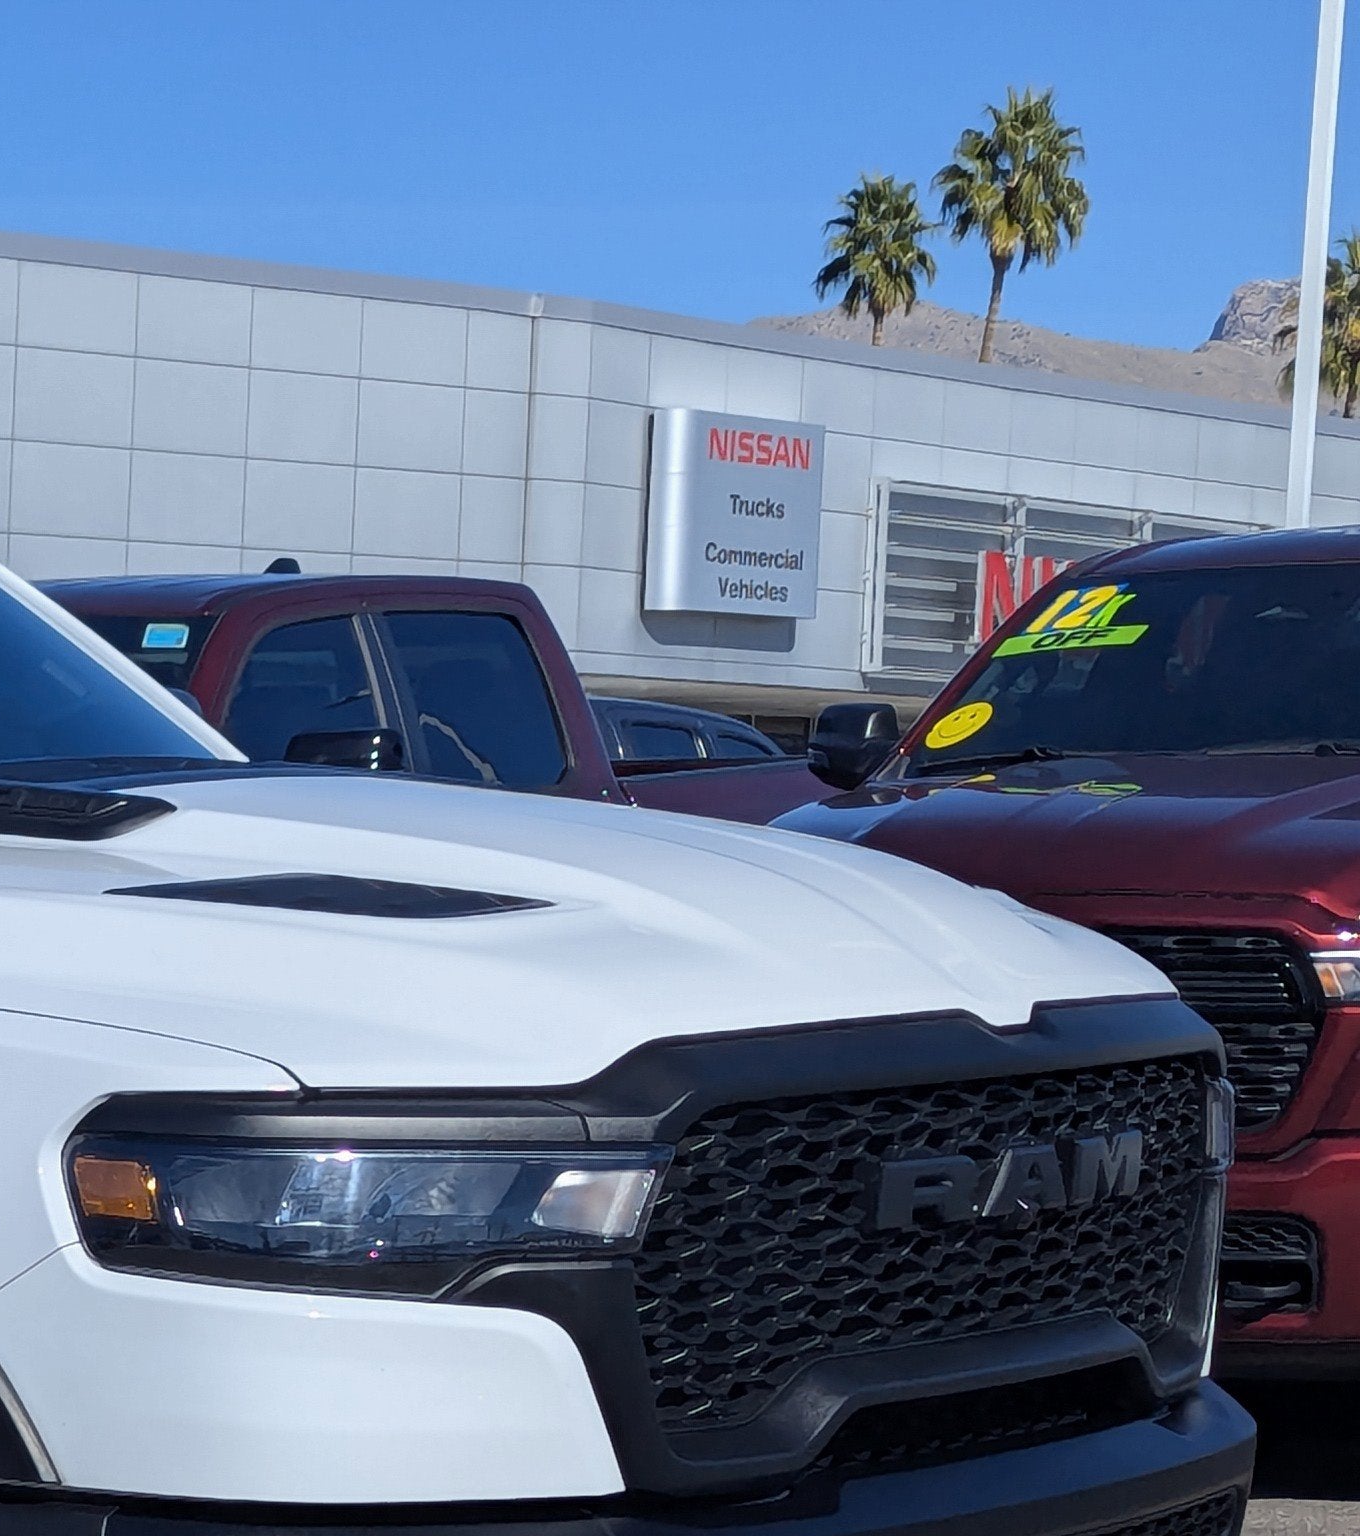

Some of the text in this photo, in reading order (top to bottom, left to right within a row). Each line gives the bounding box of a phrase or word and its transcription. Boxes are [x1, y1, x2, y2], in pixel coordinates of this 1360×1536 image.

[708, 426, 812, 471] NISSAN
[729, 494, 786, 520] Trucks
[704, 541, 804, 571] Commercial
[718, 576, 789, 603] Vehicles
[1030, 627, 1118, 650] OFF
[876, 1129, 1144, 1233] RAM
